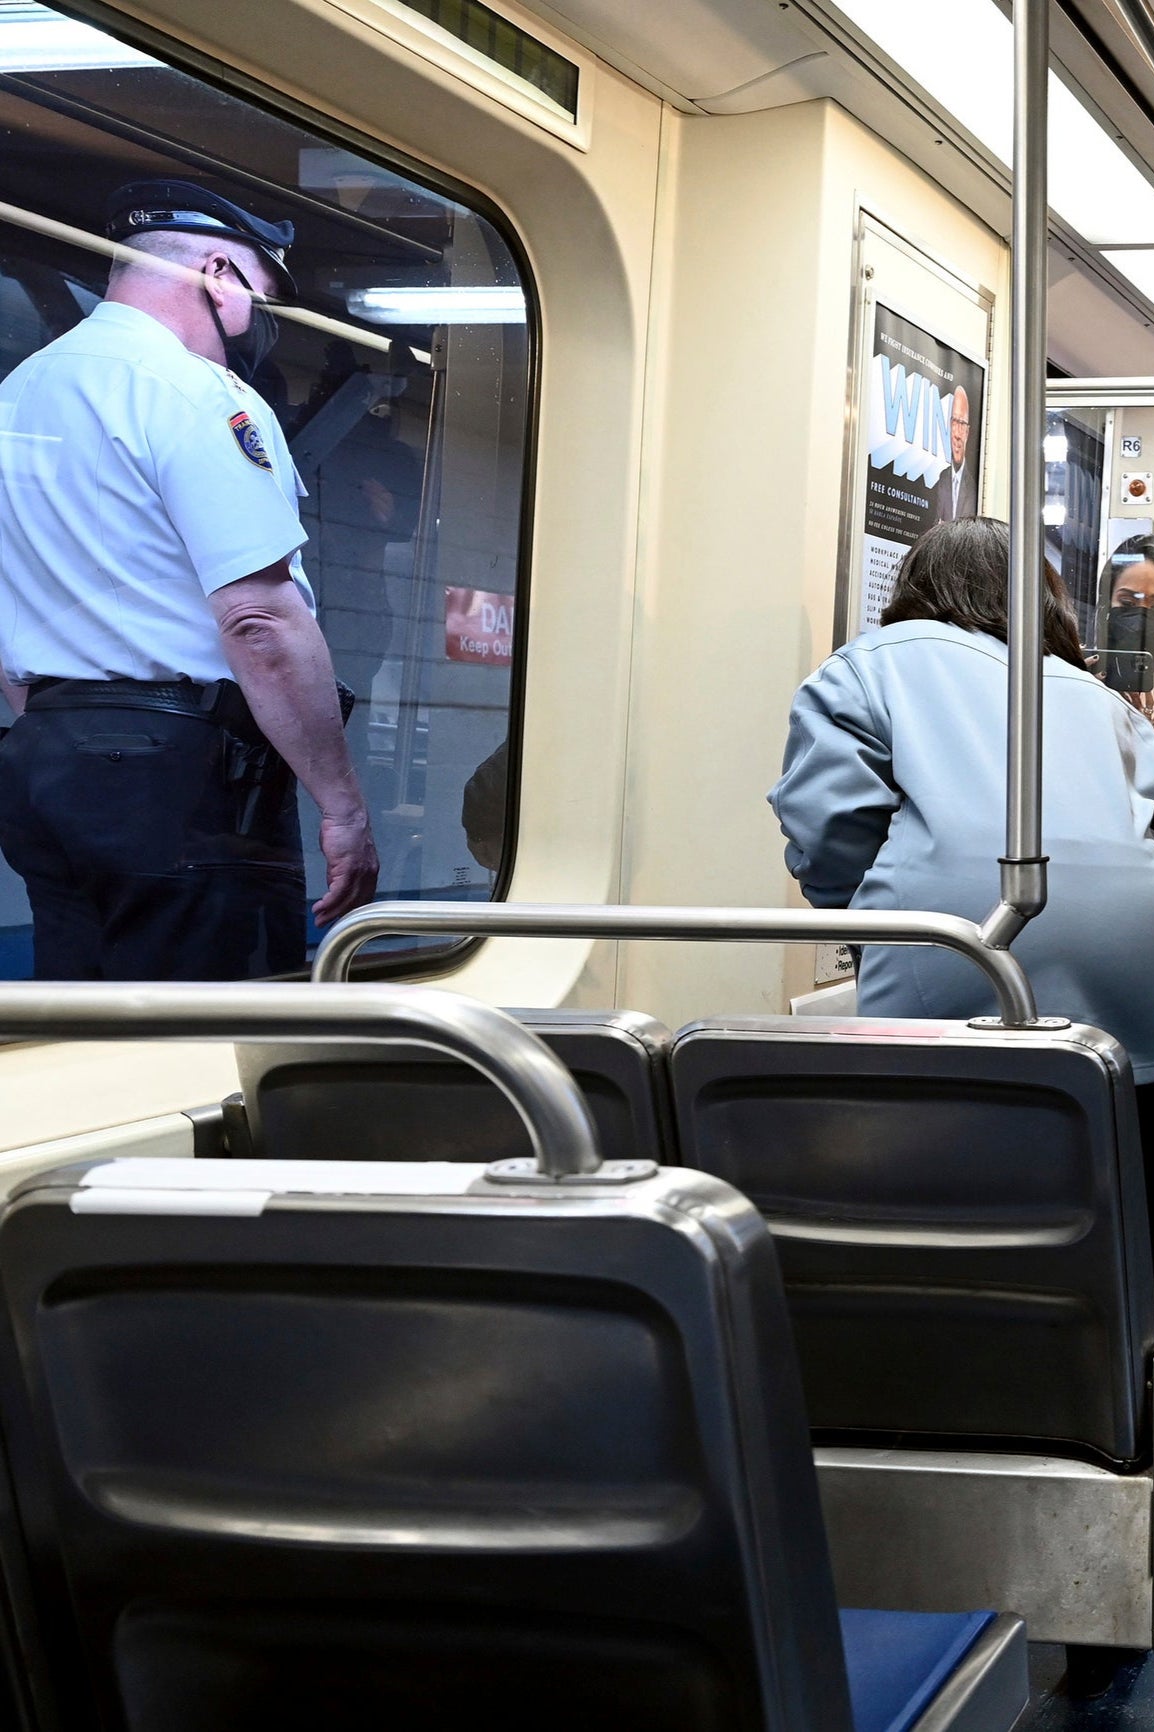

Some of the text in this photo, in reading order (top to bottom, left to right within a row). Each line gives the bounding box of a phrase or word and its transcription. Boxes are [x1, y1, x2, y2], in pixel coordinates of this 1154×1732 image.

[874, 353, 954, 468] WIN
[1122, 440, 1141, 452] R6
[870, 481, 929, 510] FREE CONSULTATION
[870, 546, 899, 559] WORKPLACE
[870, 558, 889, 568] MEDICAL
[460, 636, 513, 657] Keep Out
